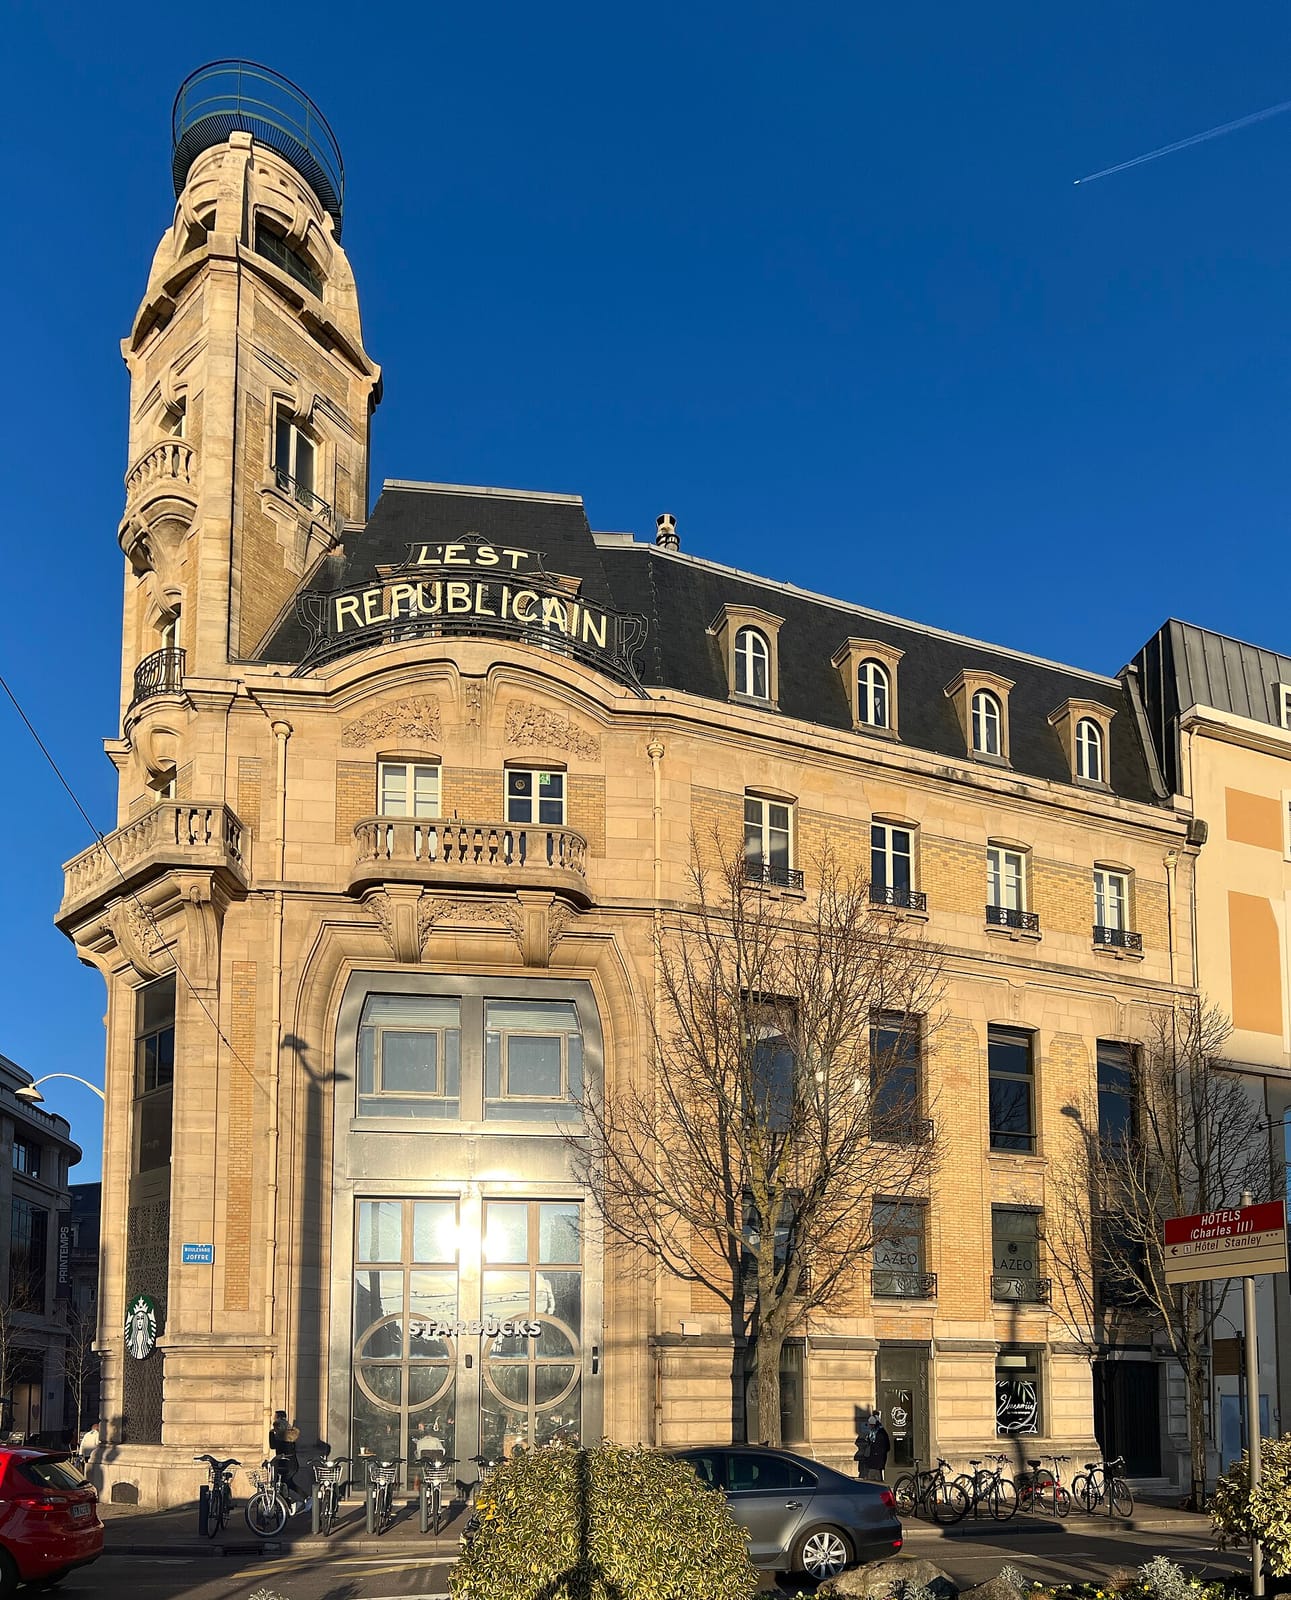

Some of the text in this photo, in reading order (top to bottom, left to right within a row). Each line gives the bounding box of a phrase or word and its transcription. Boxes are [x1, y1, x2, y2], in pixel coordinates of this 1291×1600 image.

[417, 545, 529, 569] L'EST
[335, 582, 608, 648] REPUBLICAIN
[1190, 1222, 1231, 1240] (Charles
[1195, 1235, 1262, 1253] Hôtel Stanley
[59, 1226, 69, 1284] PRINTEMPS
[874, 1252, 917, 1265] LAZEO
[993, 1258, 1033, 1271] LAZEO
[408, 1319, 542, 1336] STARBUCKS
